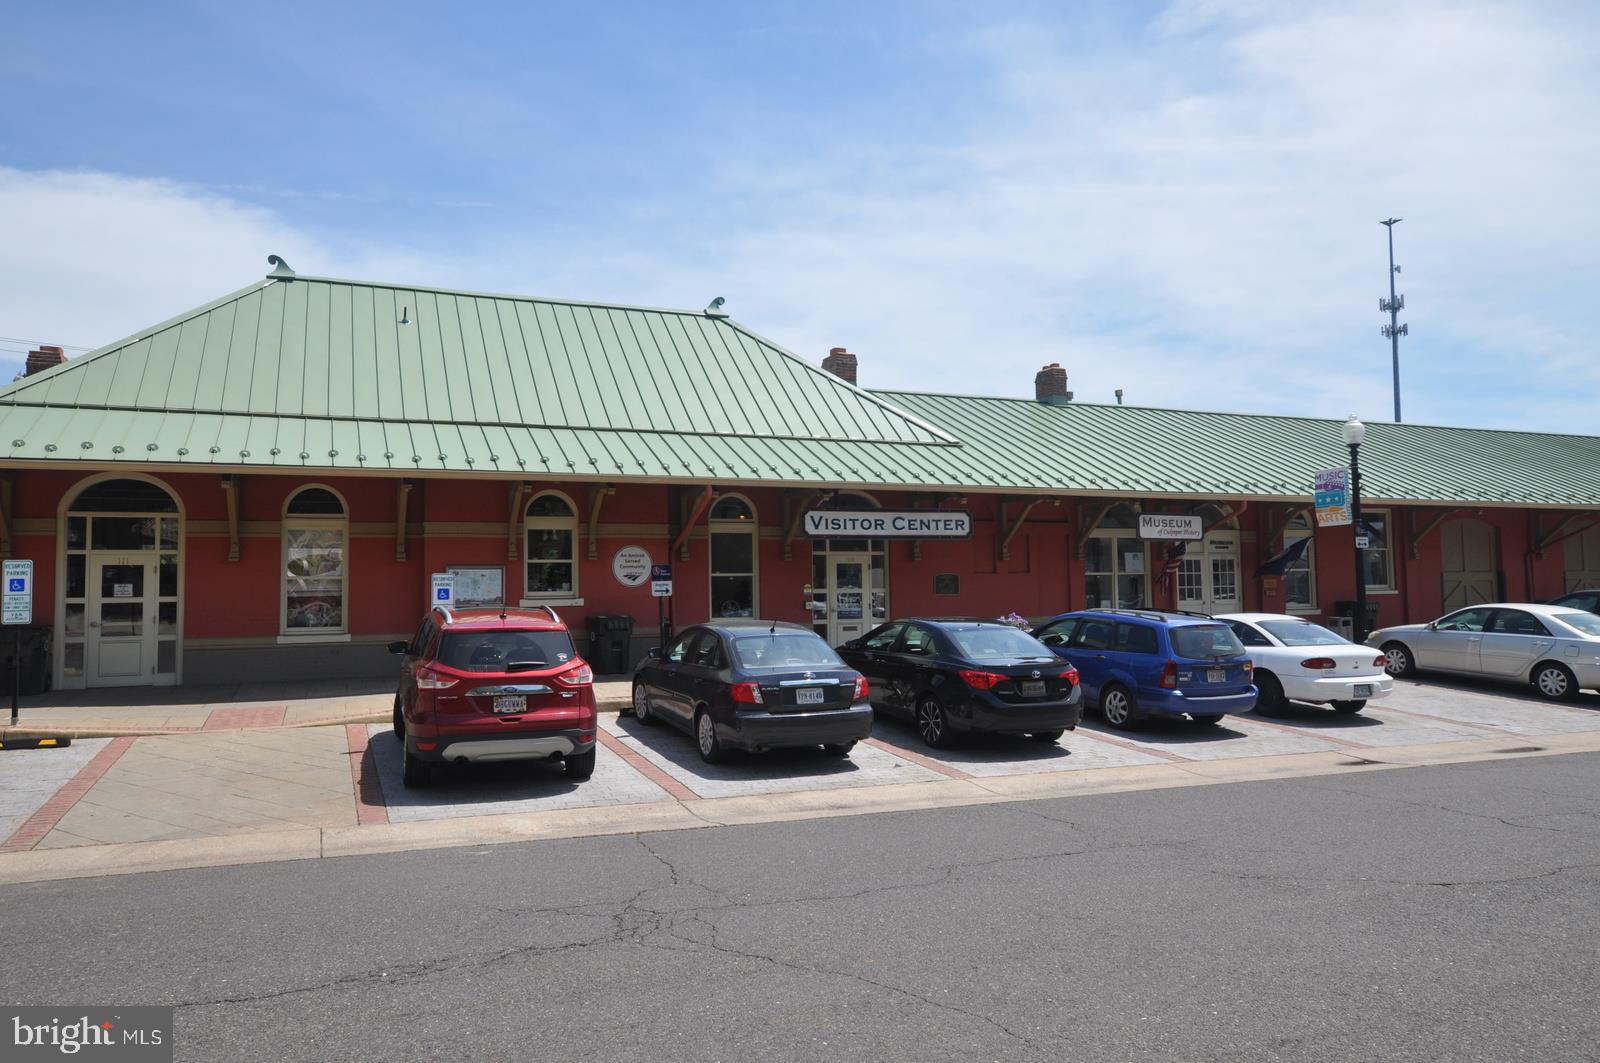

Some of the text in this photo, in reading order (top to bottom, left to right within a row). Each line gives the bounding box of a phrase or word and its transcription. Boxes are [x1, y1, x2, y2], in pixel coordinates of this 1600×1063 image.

[1315, 470, 1344, 481] MUSIC
[1142, 516, 1192, 528] MUSEUM
[1317, 511, 1347, 522] ARTS
[810, 515, 966, 531] VISITOR CENTER
